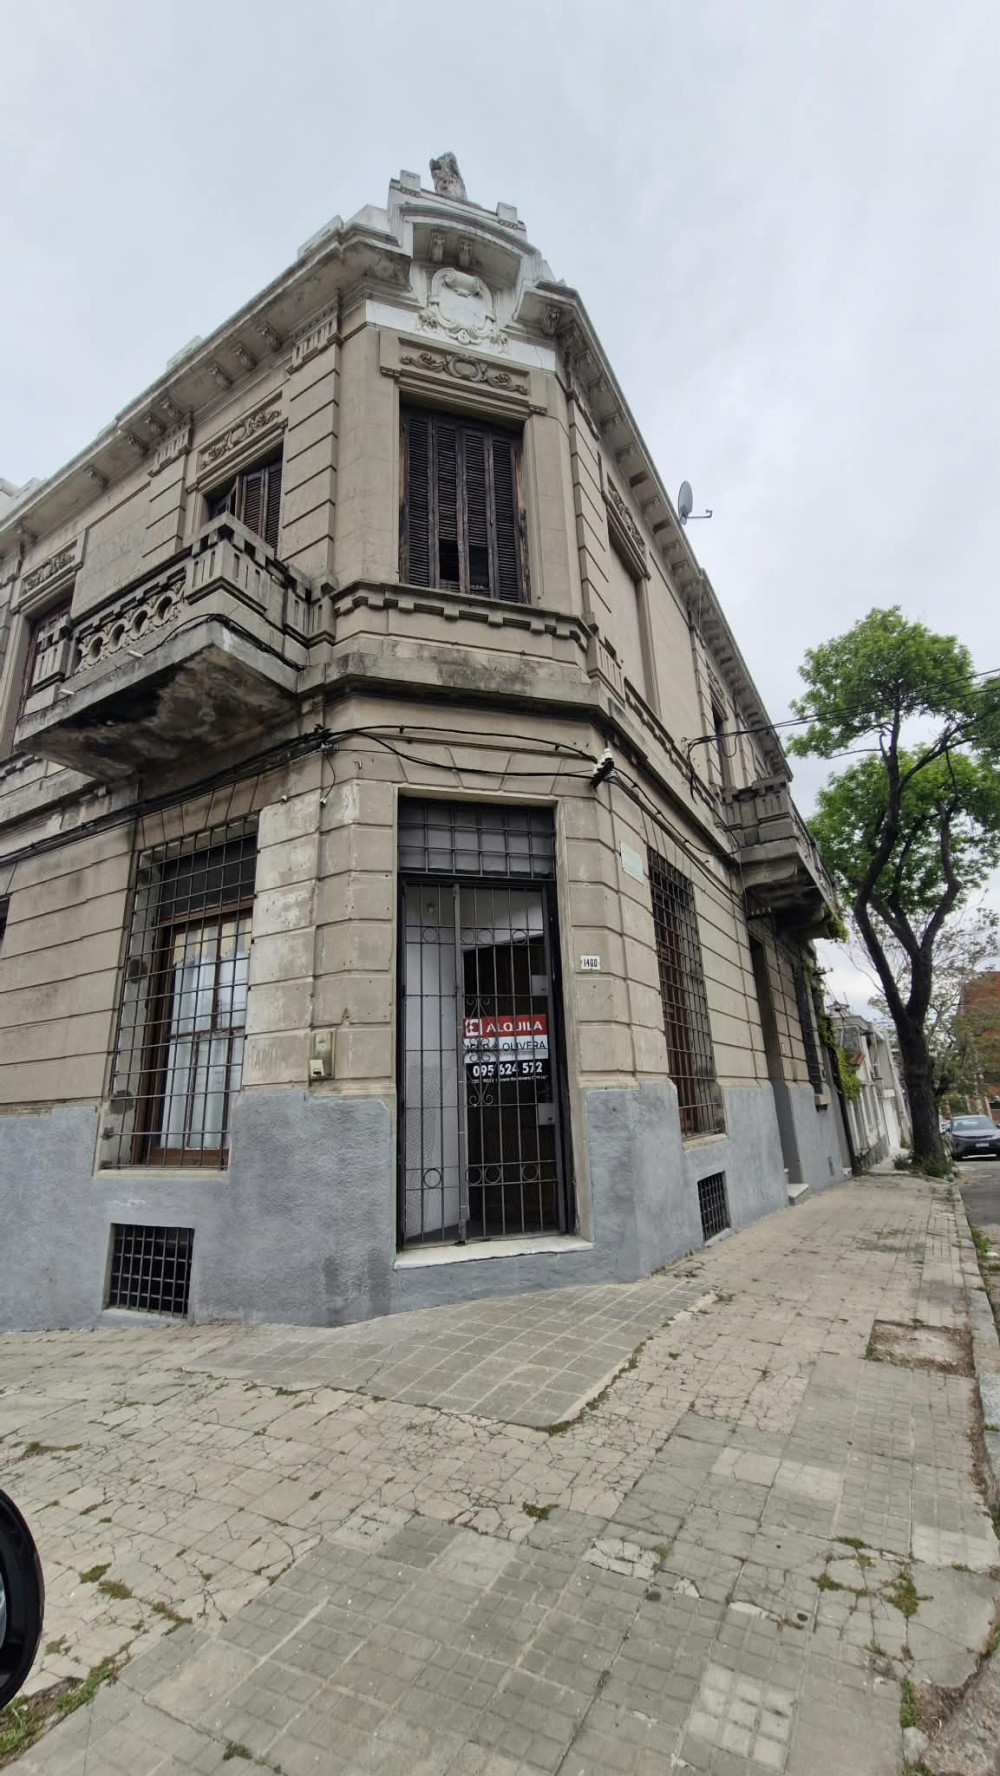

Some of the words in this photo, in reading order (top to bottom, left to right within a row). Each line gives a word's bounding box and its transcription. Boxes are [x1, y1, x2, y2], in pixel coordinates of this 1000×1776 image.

[486, 1021, 543, 1033] ALQUILA
[502, 1041, 546, 1051] OLIVERA
[473, 1065, 494, 1077] 095
[499, 1064, 518, 1075] 624
[522, 1062, 543, 1073] 572
